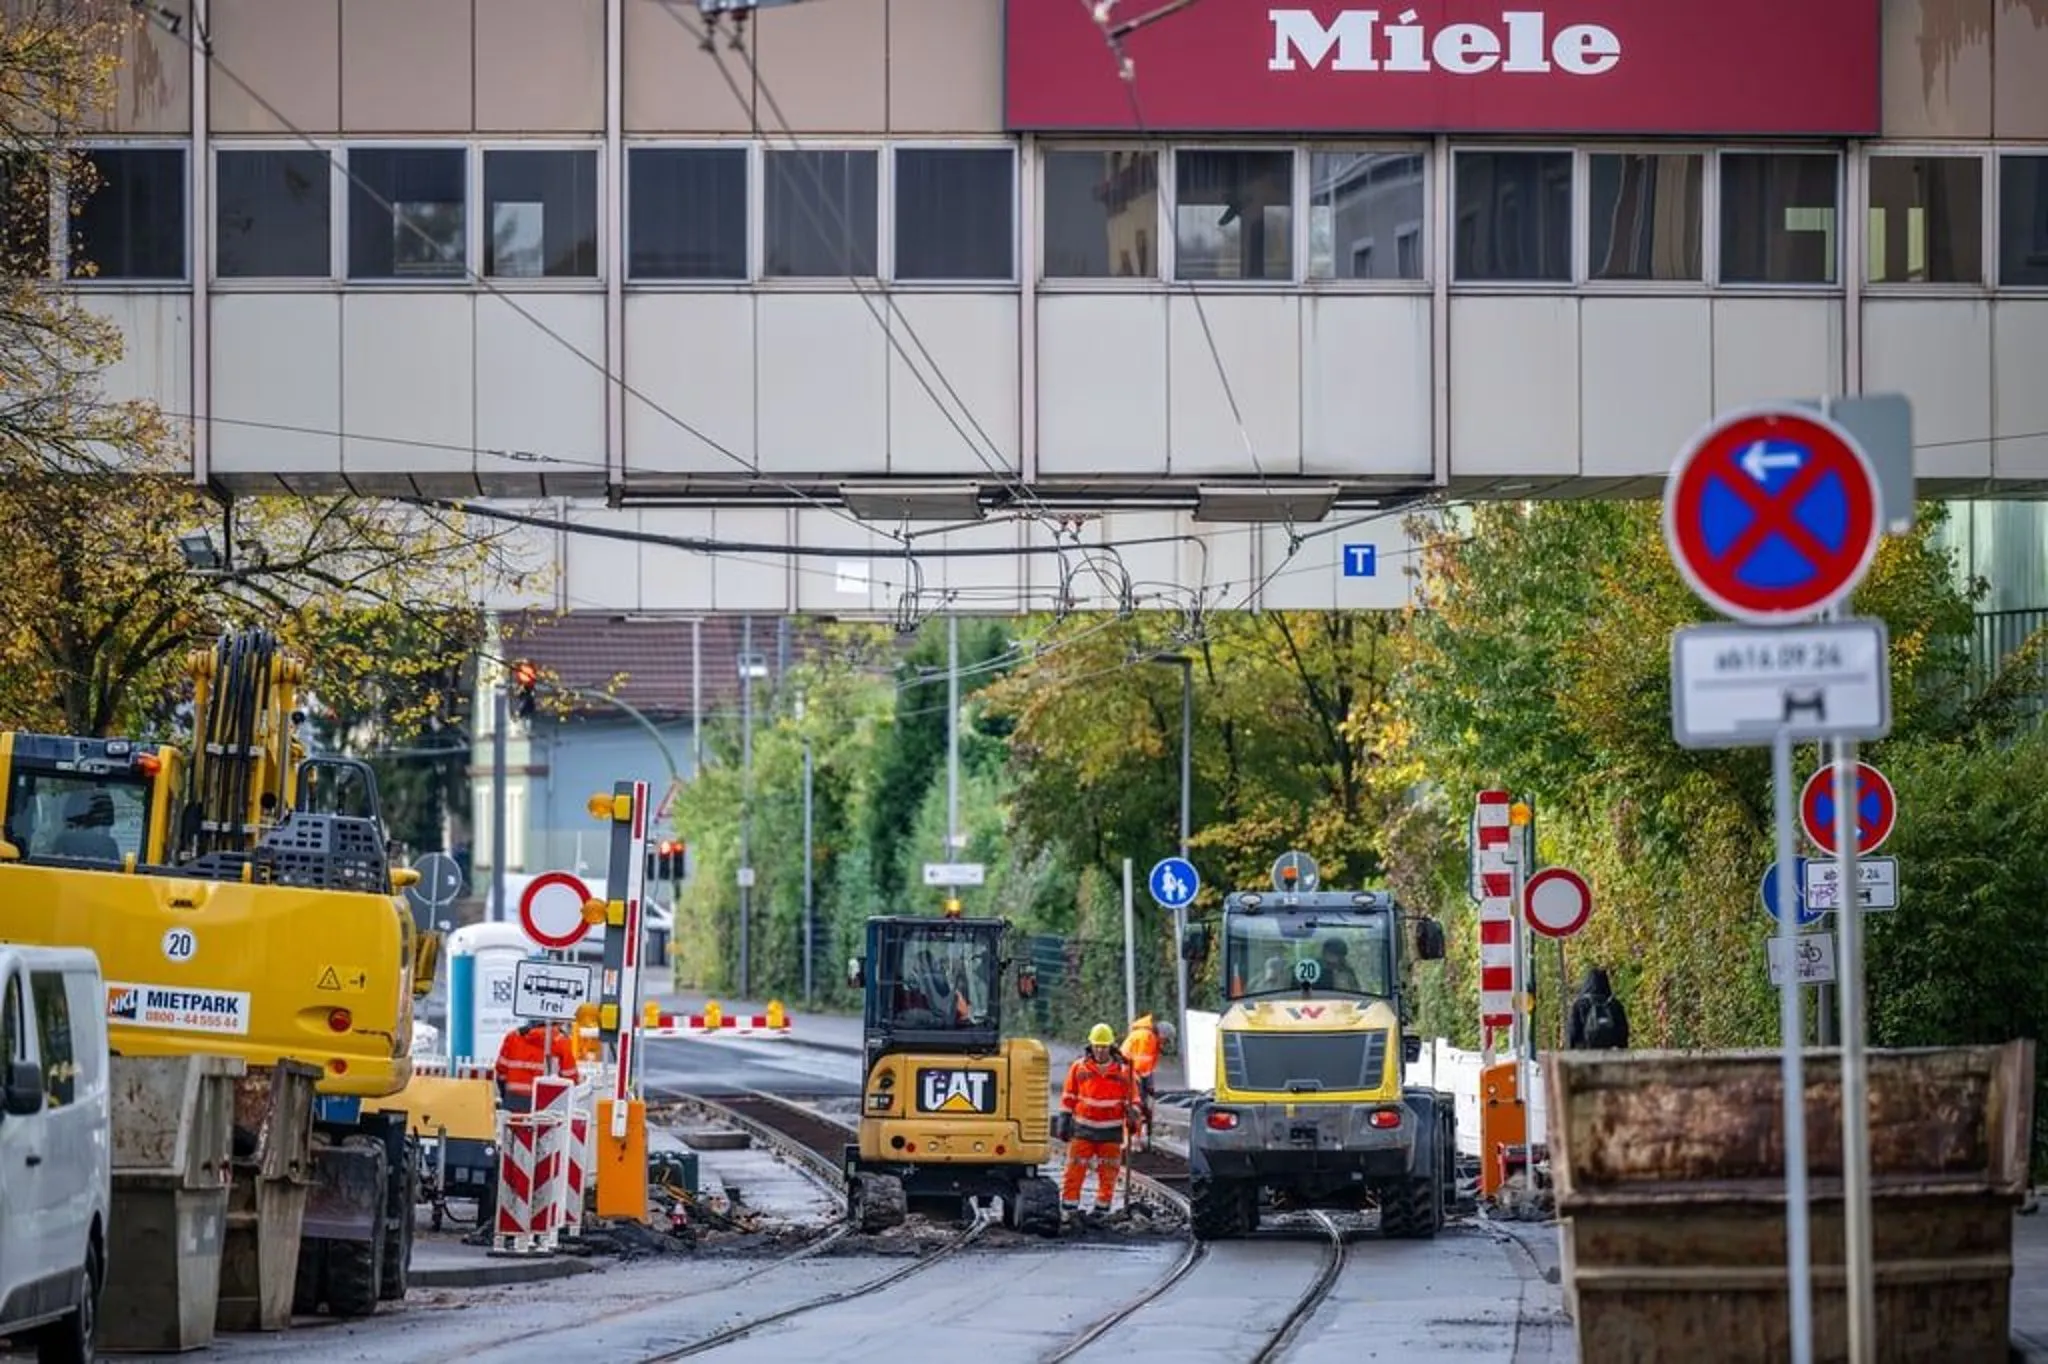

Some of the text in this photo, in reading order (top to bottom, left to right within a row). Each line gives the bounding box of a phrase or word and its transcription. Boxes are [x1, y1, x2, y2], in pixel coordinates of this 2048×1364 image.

[1268, 9, 1621, 75] Miele
[1349, 547, 1371, 573] T
[169, 933, 191, 957] 20
[1300, 963, 1315, 979] 20
[146, 990, 240, 1014] MIETPARK
[540, 999, 564, 1013] frei
[924, 1070, 989, 1113] CAT
